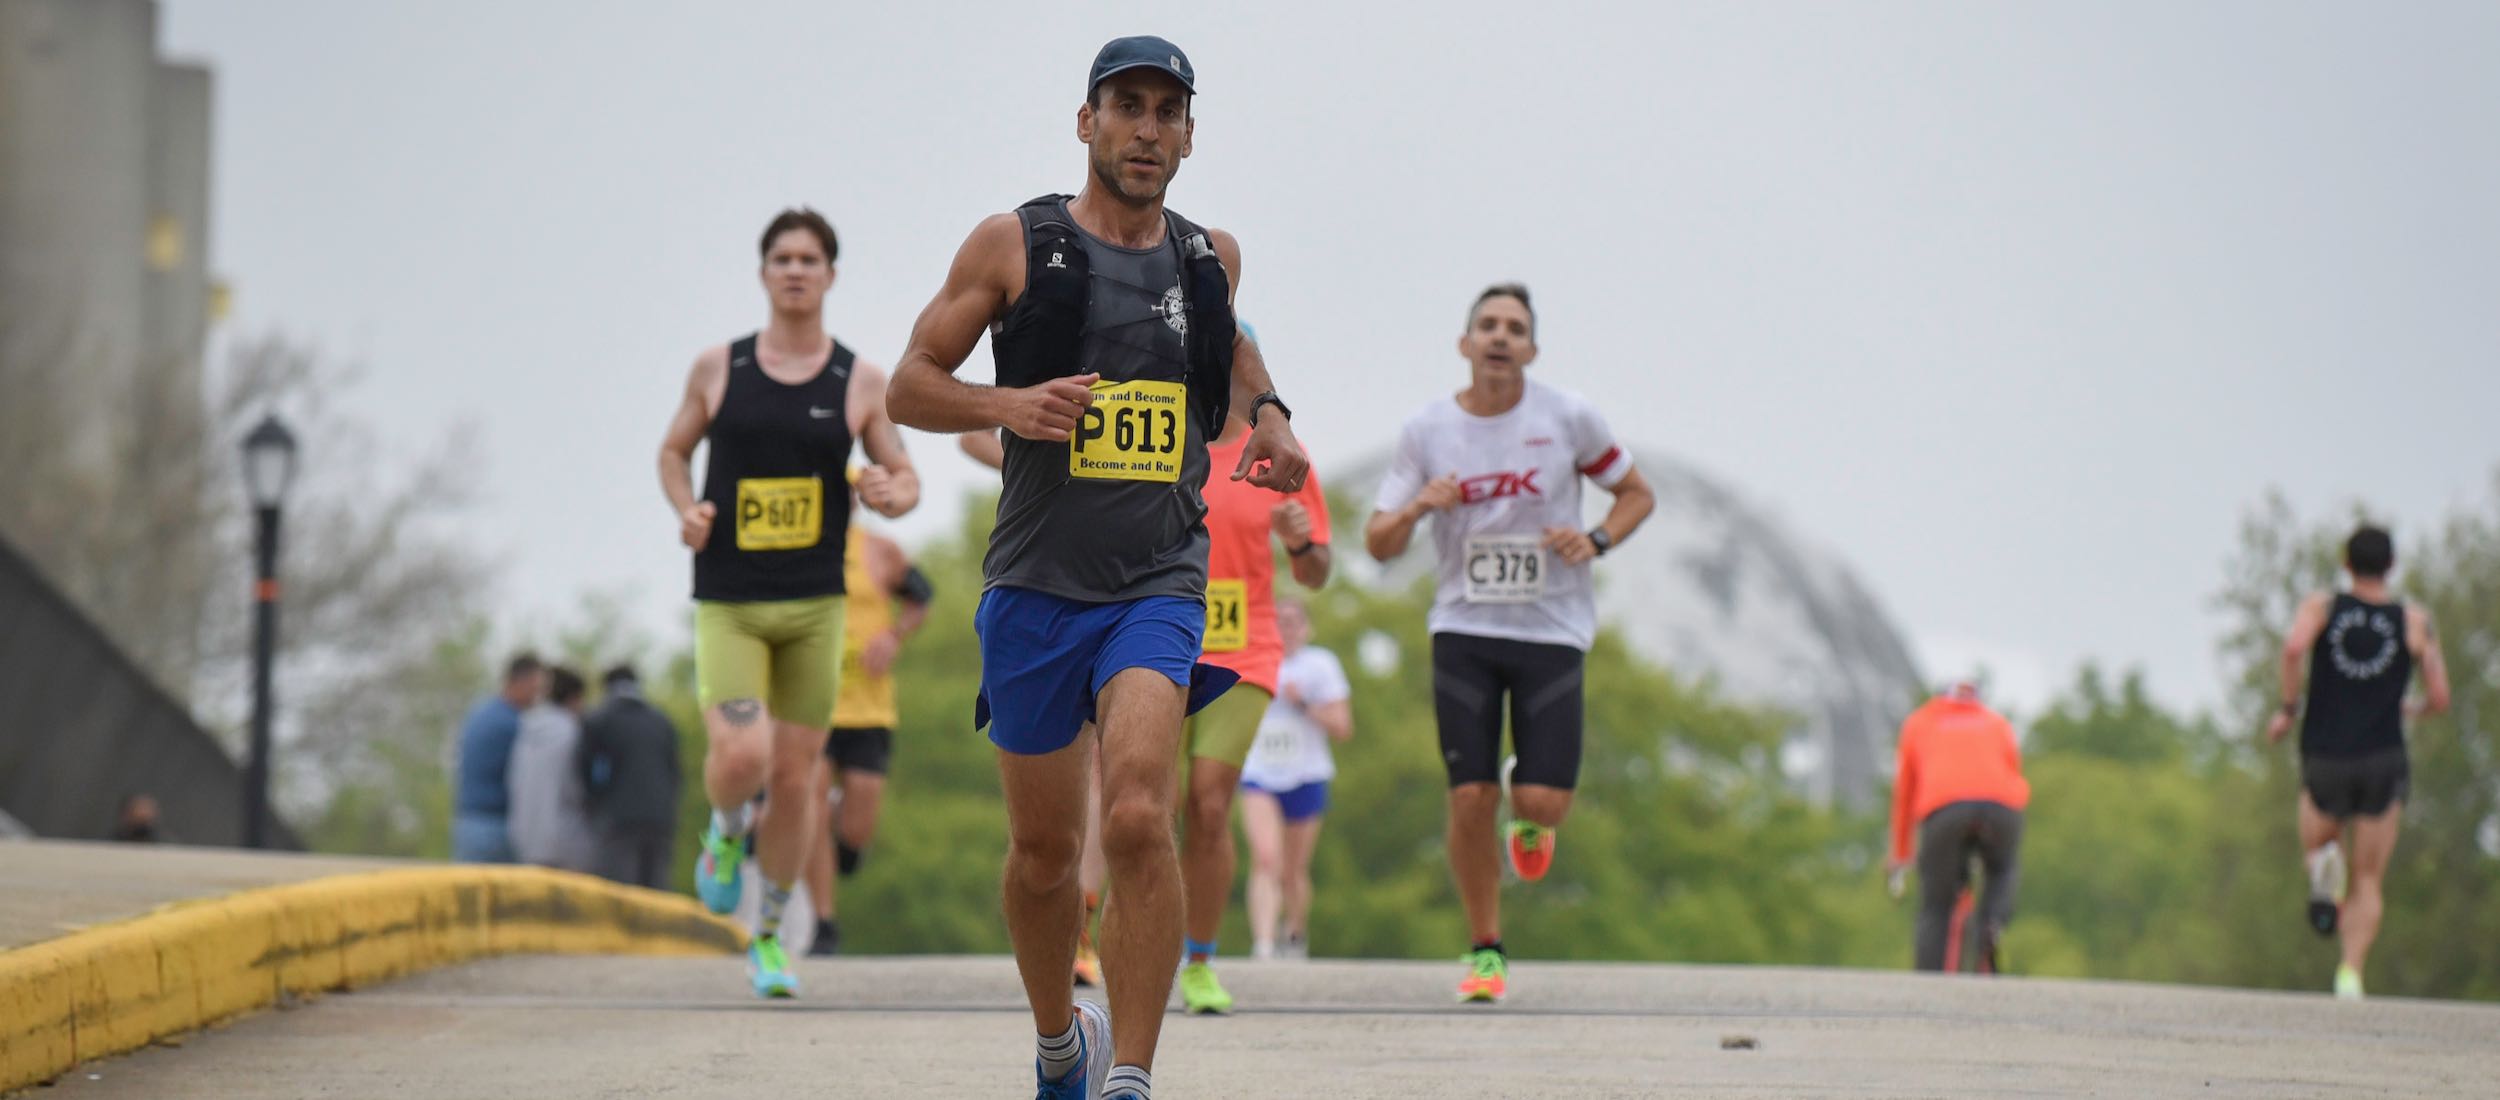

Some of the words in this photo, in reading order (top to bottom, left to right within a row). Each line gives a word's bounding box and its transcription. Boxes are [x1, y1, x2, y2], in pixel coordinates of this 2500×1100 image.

[1110, 390, 1131, 401] and
[1135, 390, 1176, 404] Become
[1074, 406, 1105, 454] P
[1115, 406, 1176, 454] 613
[1080, 457, 1127, 470] Become
[1131, 460, 1152, 471] and
[1156, 462, 1174, 473] Run
[742, 497, 763, 530] P
[1469, 554, 1488, 584] C
[1496, 553, 1538, 584] 379
[1206, 600, 1238, 631] 34
